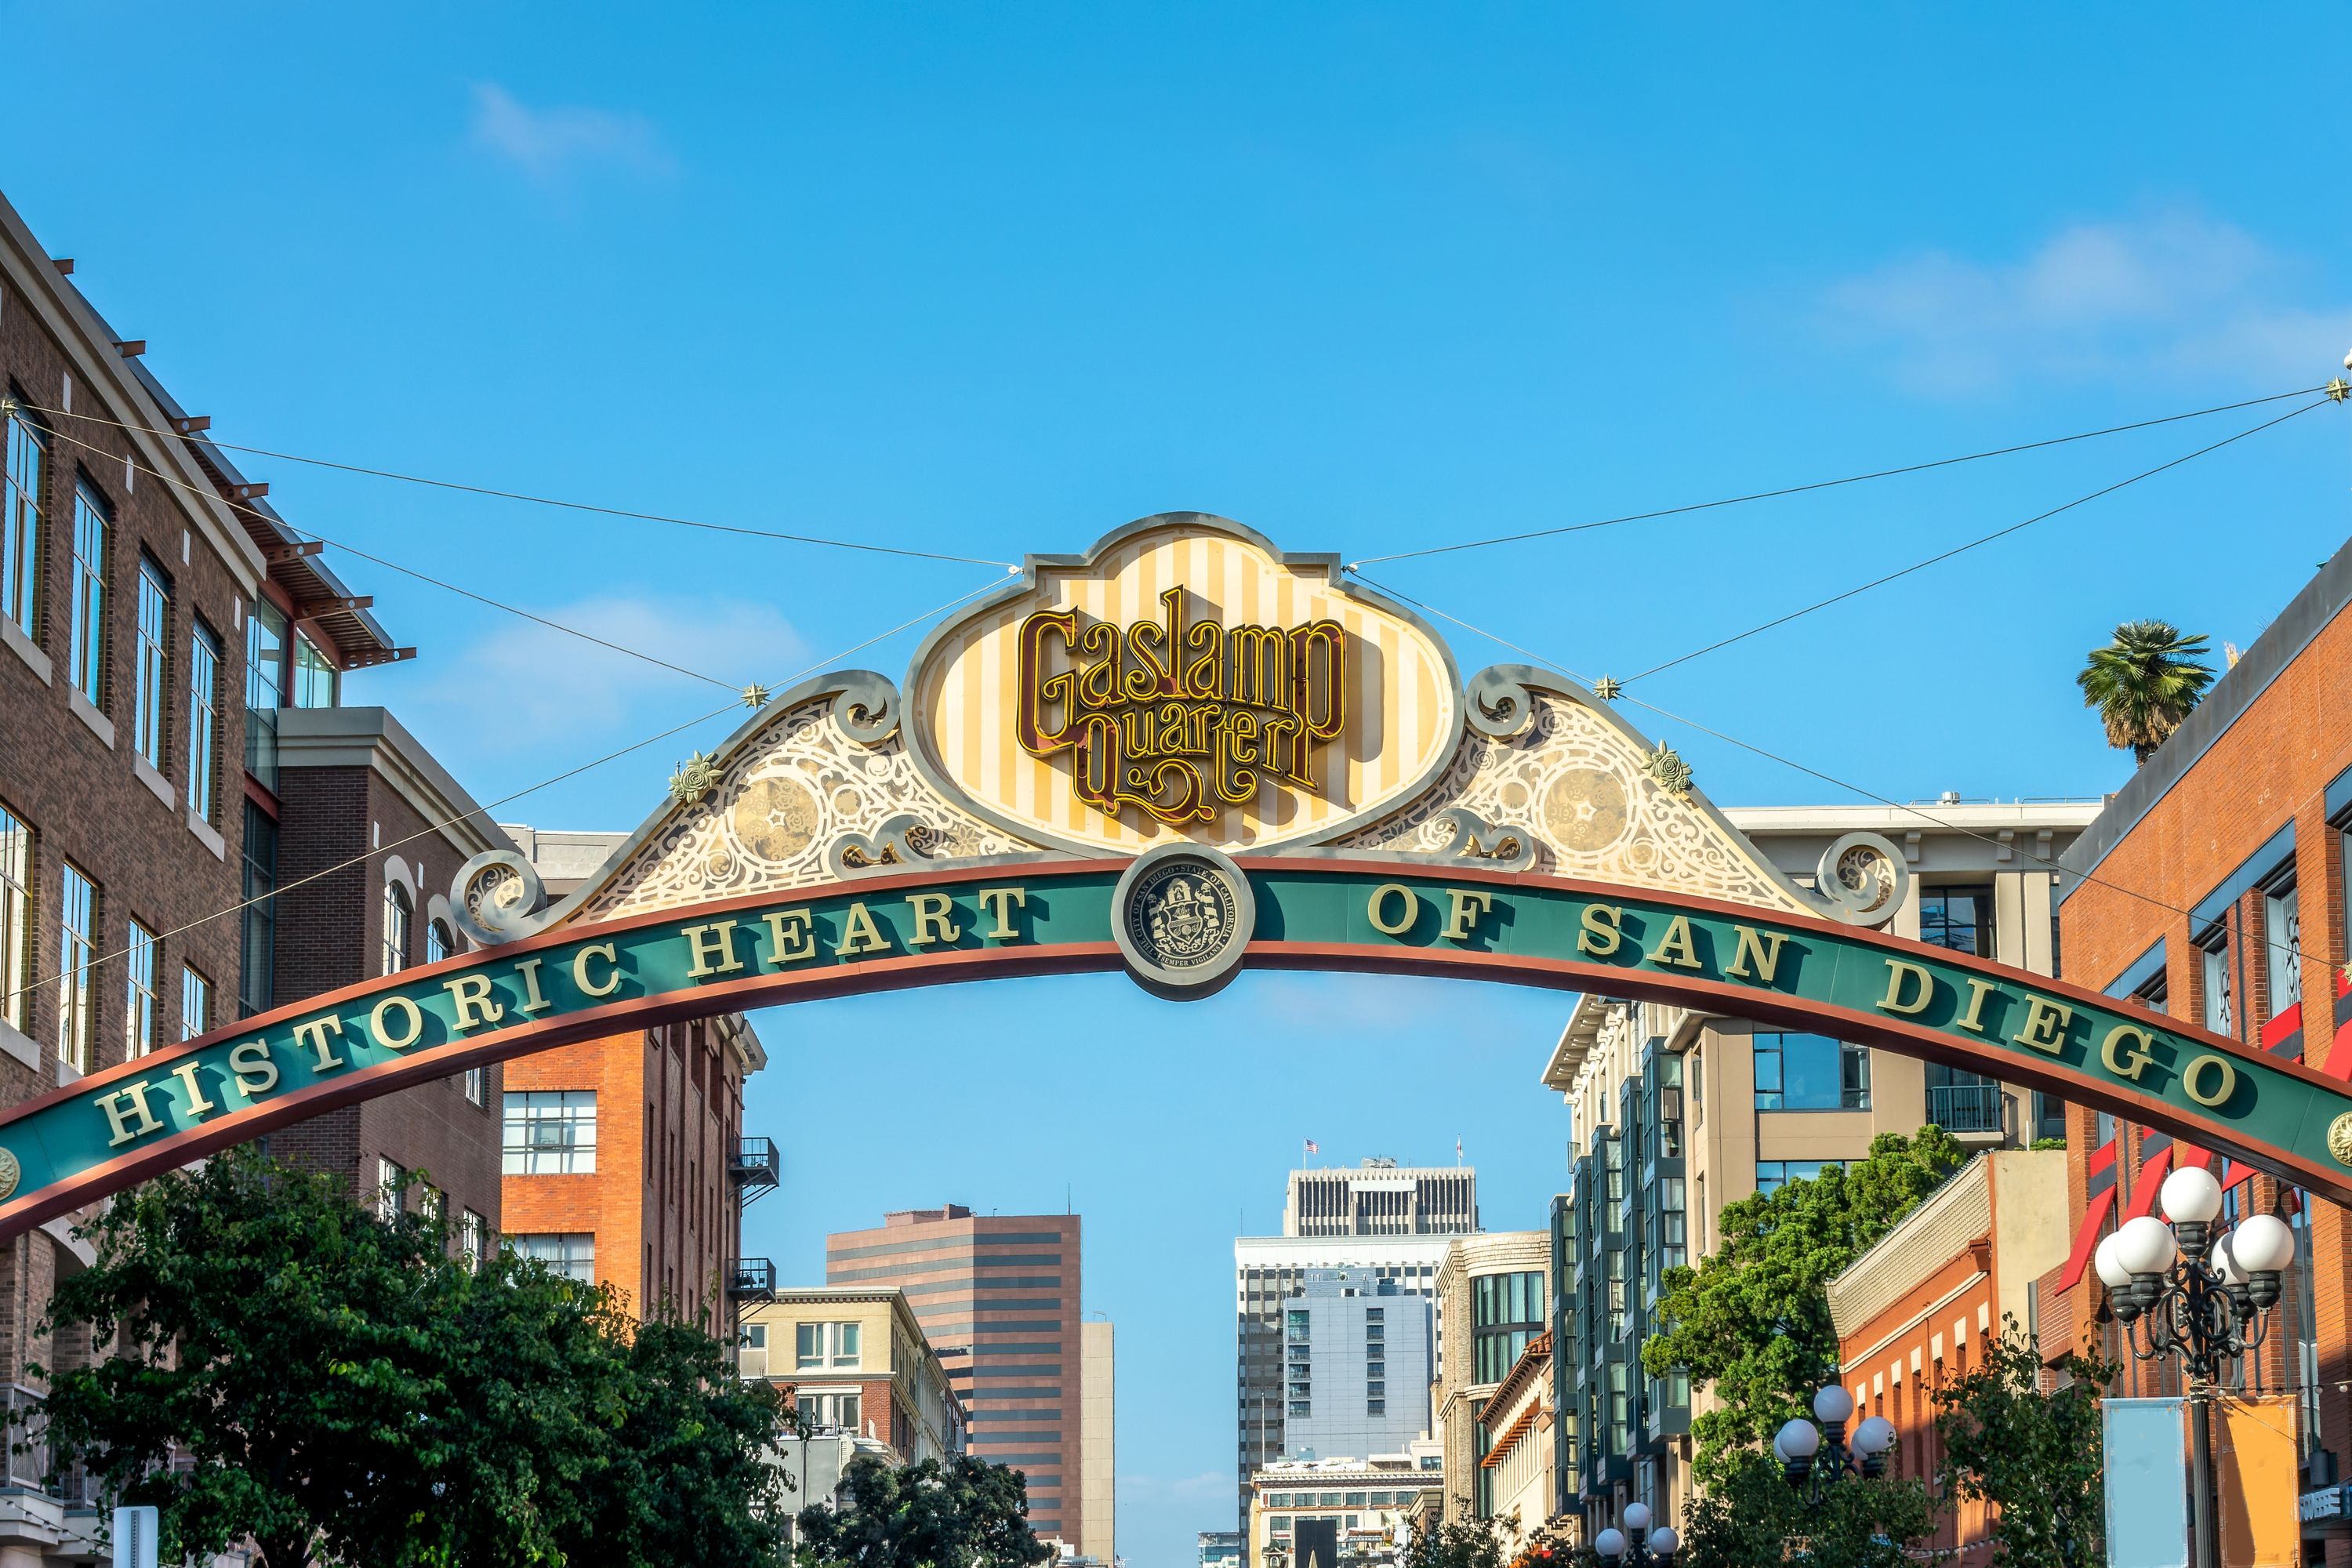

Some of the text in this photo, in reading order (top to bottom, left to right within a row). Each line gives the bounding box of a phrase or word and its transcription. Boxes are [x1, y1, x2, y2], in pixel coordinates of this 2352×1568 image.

[1016, 584, 1347, 794] Gaslamp
[1073, 702, 1298, 827] Quarter
[1132, 867, 1174, 956] THE CITY OF SAN DIEGO
[1160, 945, 1221, 966] SEMPER VIGILANS
[1181, 866, 1236, 938] STATE OF CALIFORNIA
[93, 884, 2236, 1147] HISTORIC HEART OF SAN DIEGO
